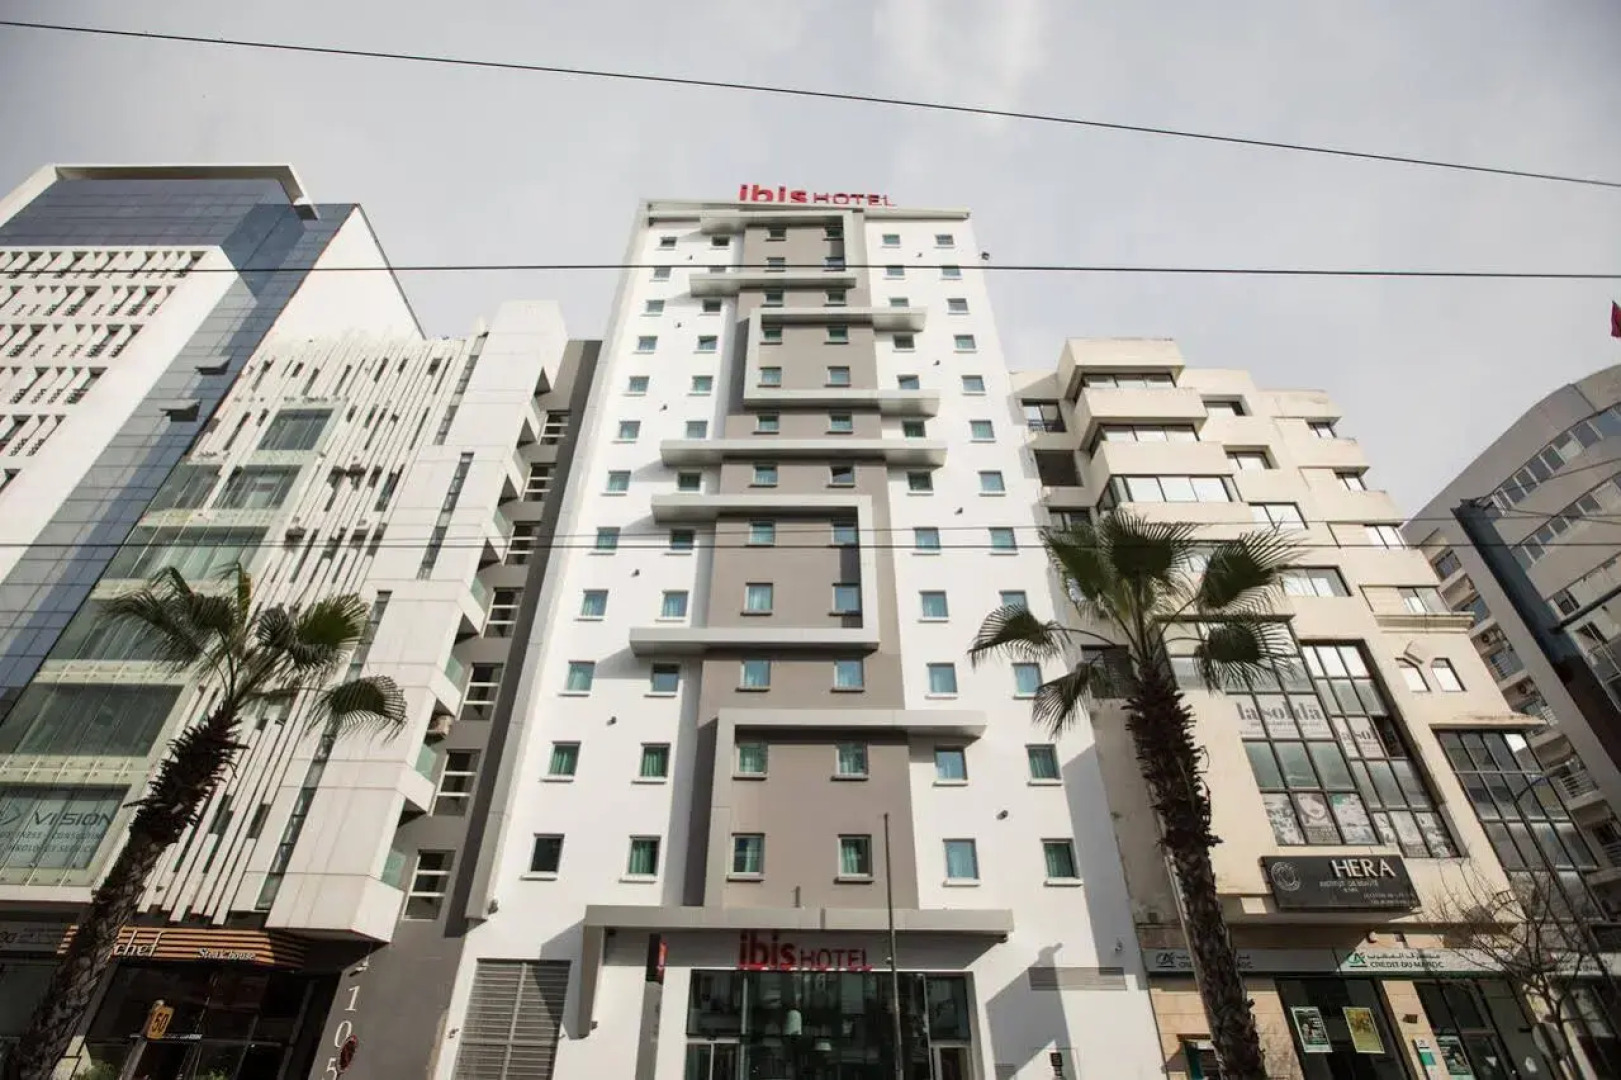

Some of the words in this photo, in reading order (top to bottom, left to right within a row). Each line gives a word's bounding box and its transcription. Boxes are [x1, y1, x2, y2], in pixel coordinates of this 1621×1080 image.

[739, 184, 807, 204] ibis
[813, 192, 897, 207] HOTEL
[1331, 858, 1396, 878] HERA
[112, 928, 168, 957] chef
[739, 929, 797, 970] ibis
[800, 948, 873, 972] HOTEL
